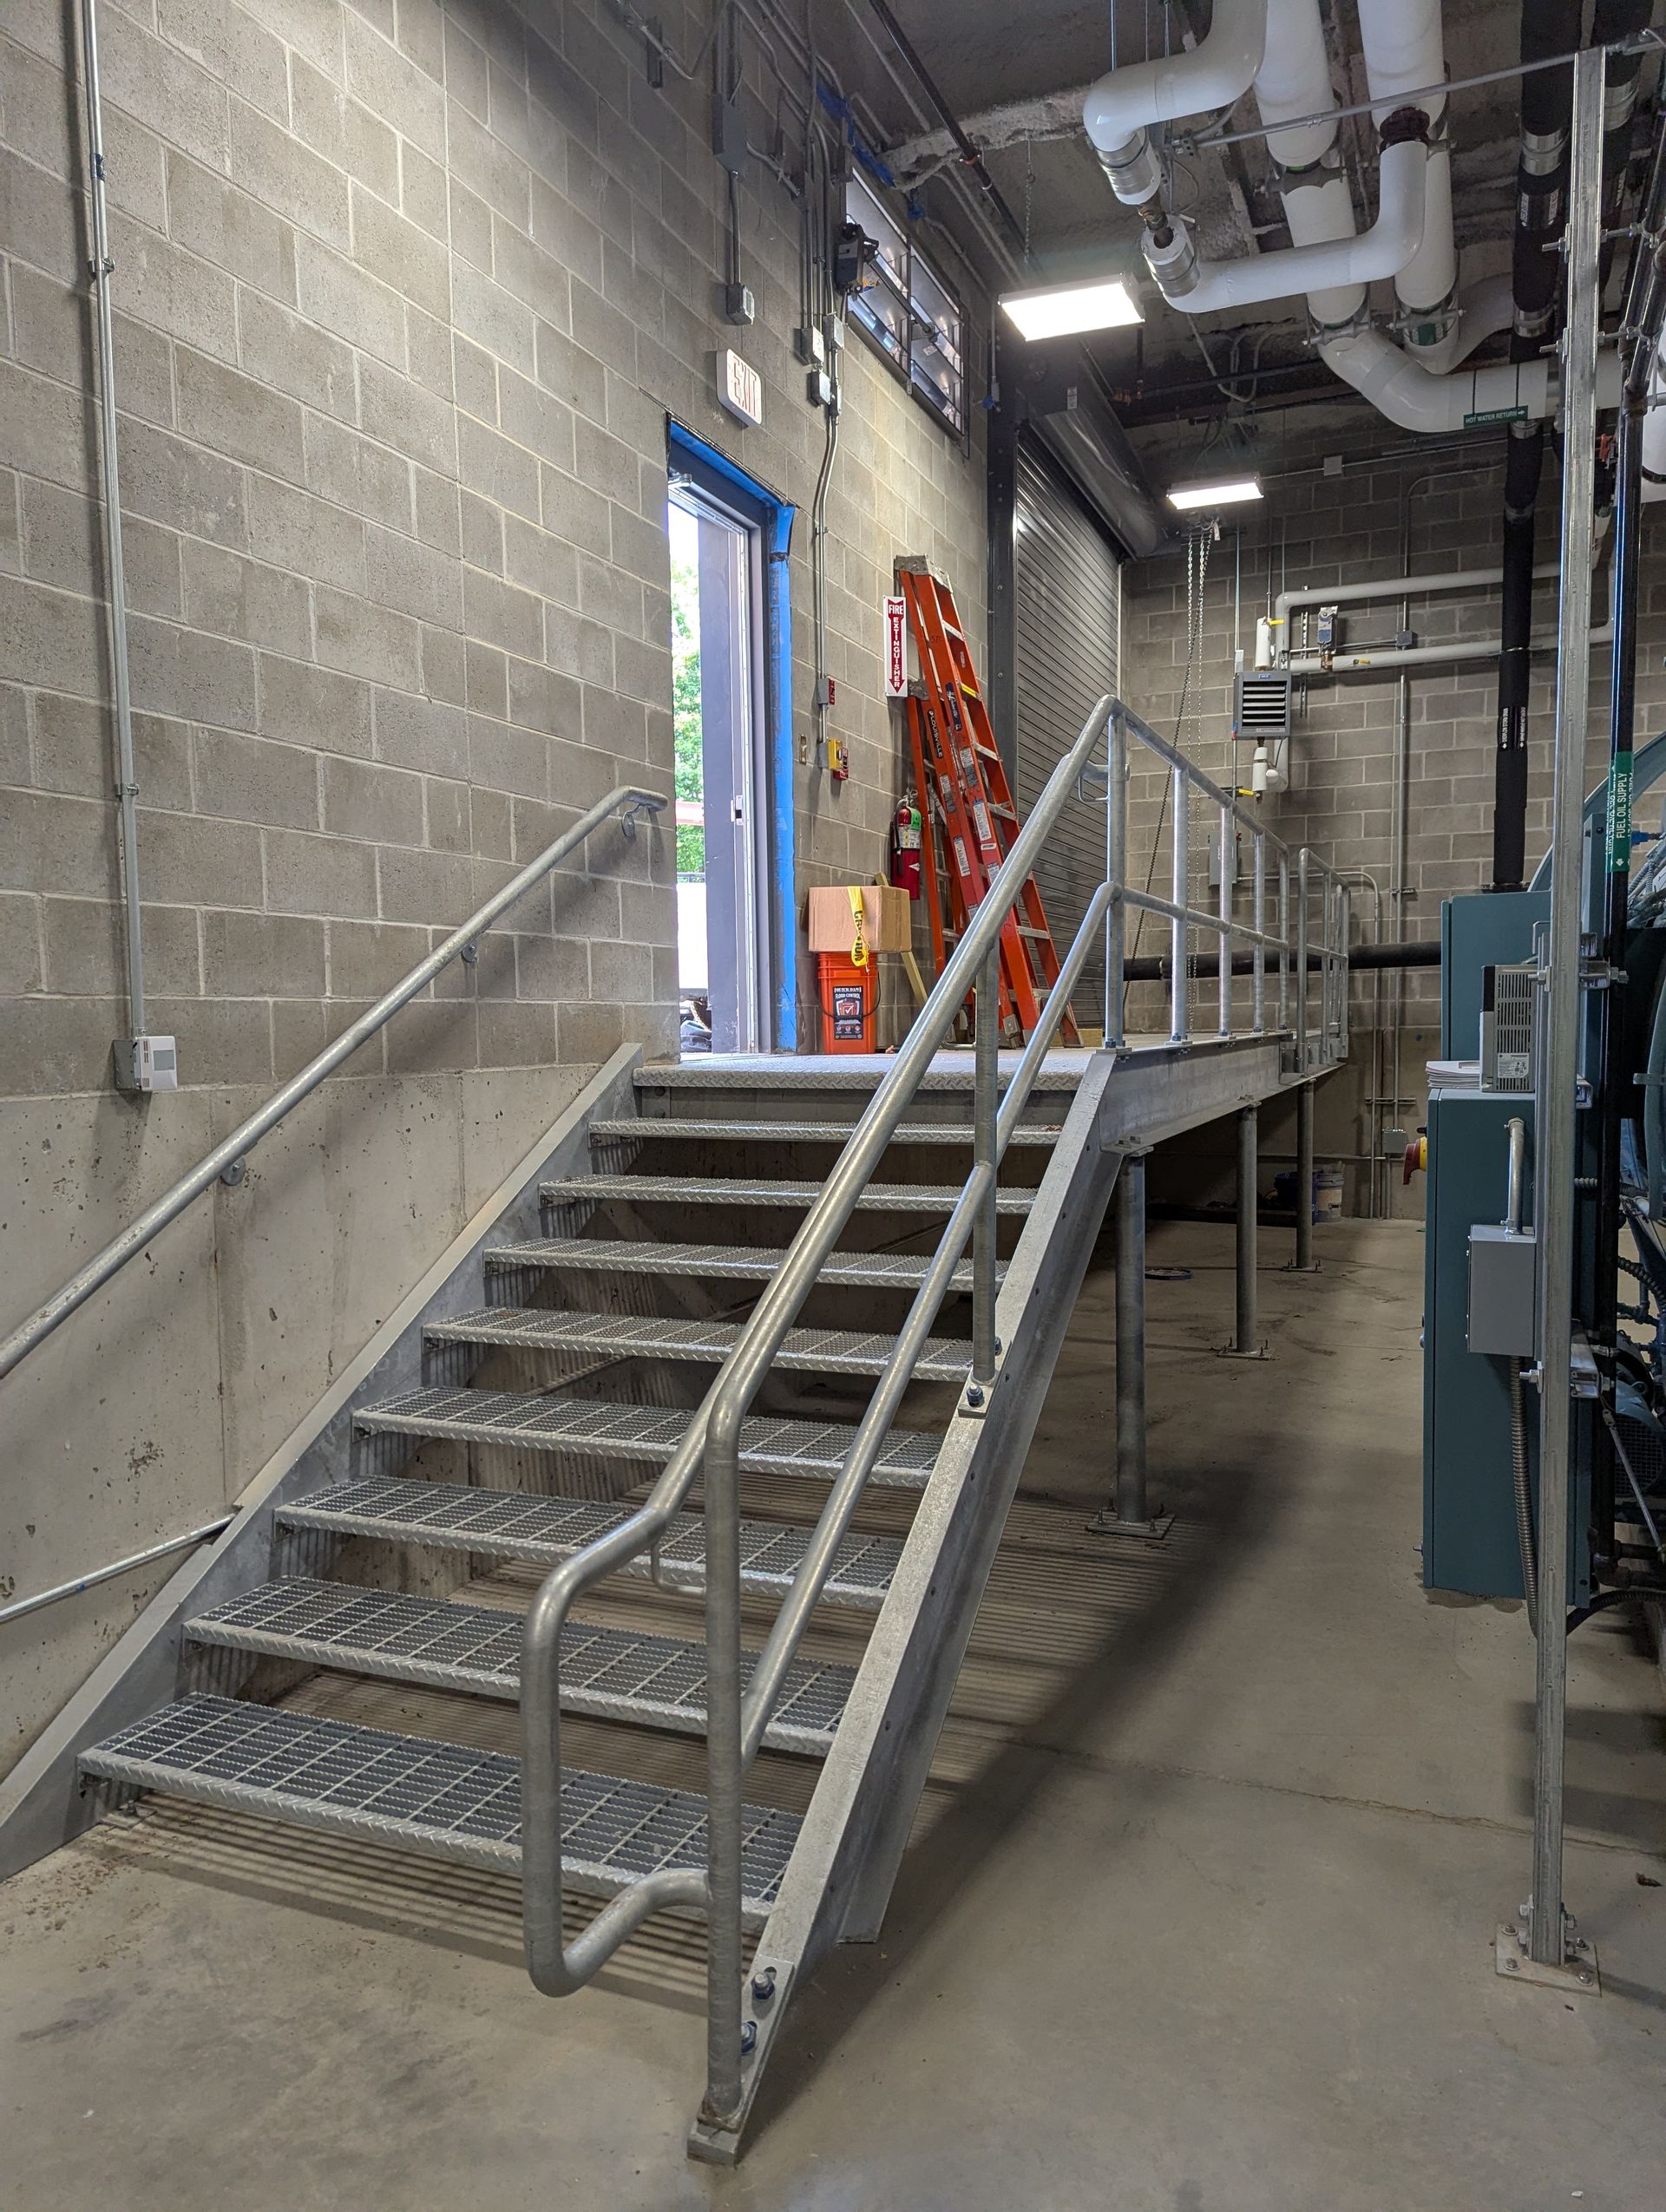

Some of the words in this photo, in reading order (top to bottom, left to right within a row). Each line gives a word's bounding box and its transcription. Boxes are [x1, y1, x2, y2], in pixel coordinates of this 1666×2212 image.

[732, 355, 757, 417] EXIT
[1496, 409, 1517, 419] RETURN
[889, 605, 903, 614] FIRE
[930, 716, 943, 757] LOUISVILLE
[1617, 773, 1628, 803] SUPPLY
[1617, 804, 1626, 817] OIL
[1617, 819, 1626, 839] FUEL
